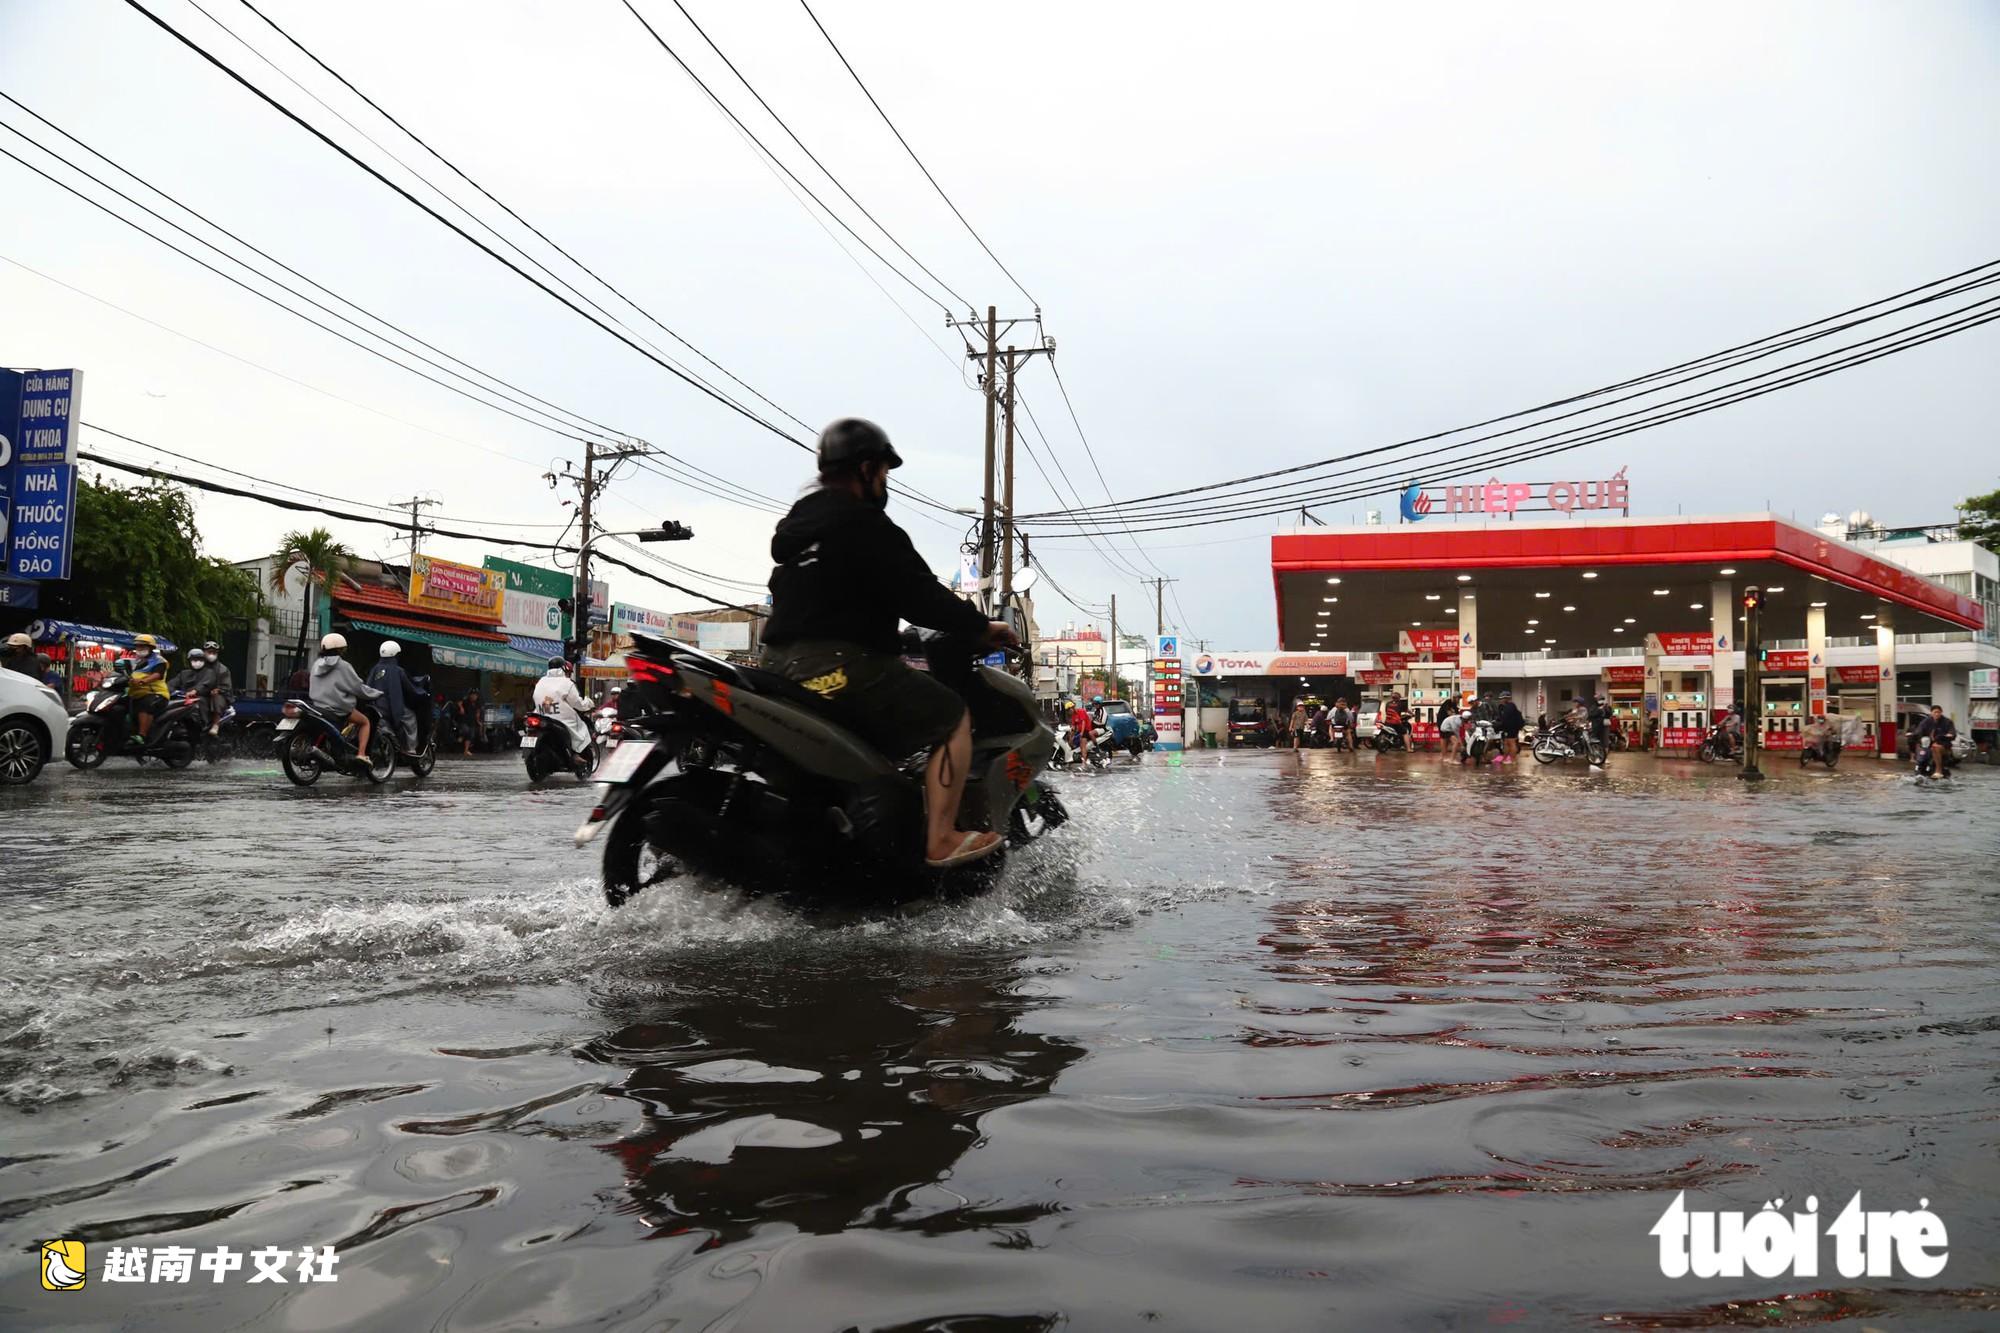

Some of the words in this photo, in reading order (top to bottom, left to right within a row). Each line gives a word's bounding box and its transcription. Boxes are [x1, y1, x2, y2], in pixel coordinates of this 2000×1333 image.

[26, 374, 43, 392] CỬA
[45, 375, 69, 391] HÀNG
[22, 399, 52, 422] DỤNG
[54, 398, 69, 420] CỤ
[25, 430, 32, 448] Y
[33, 429, 61, 448] KHOA
[24, 468, 58, 492] NHÀ
[1446, 476, 1531, 518] HIỆP
[1547, 465, 1629, 513] QUẾ
[16, 500, 64, 523] THUỐC
[15, 530, 59, 550] HỒNG
[19, 556, 52, 573] ĐÀO
[1218, 658, 1262, 669] TOTAL
